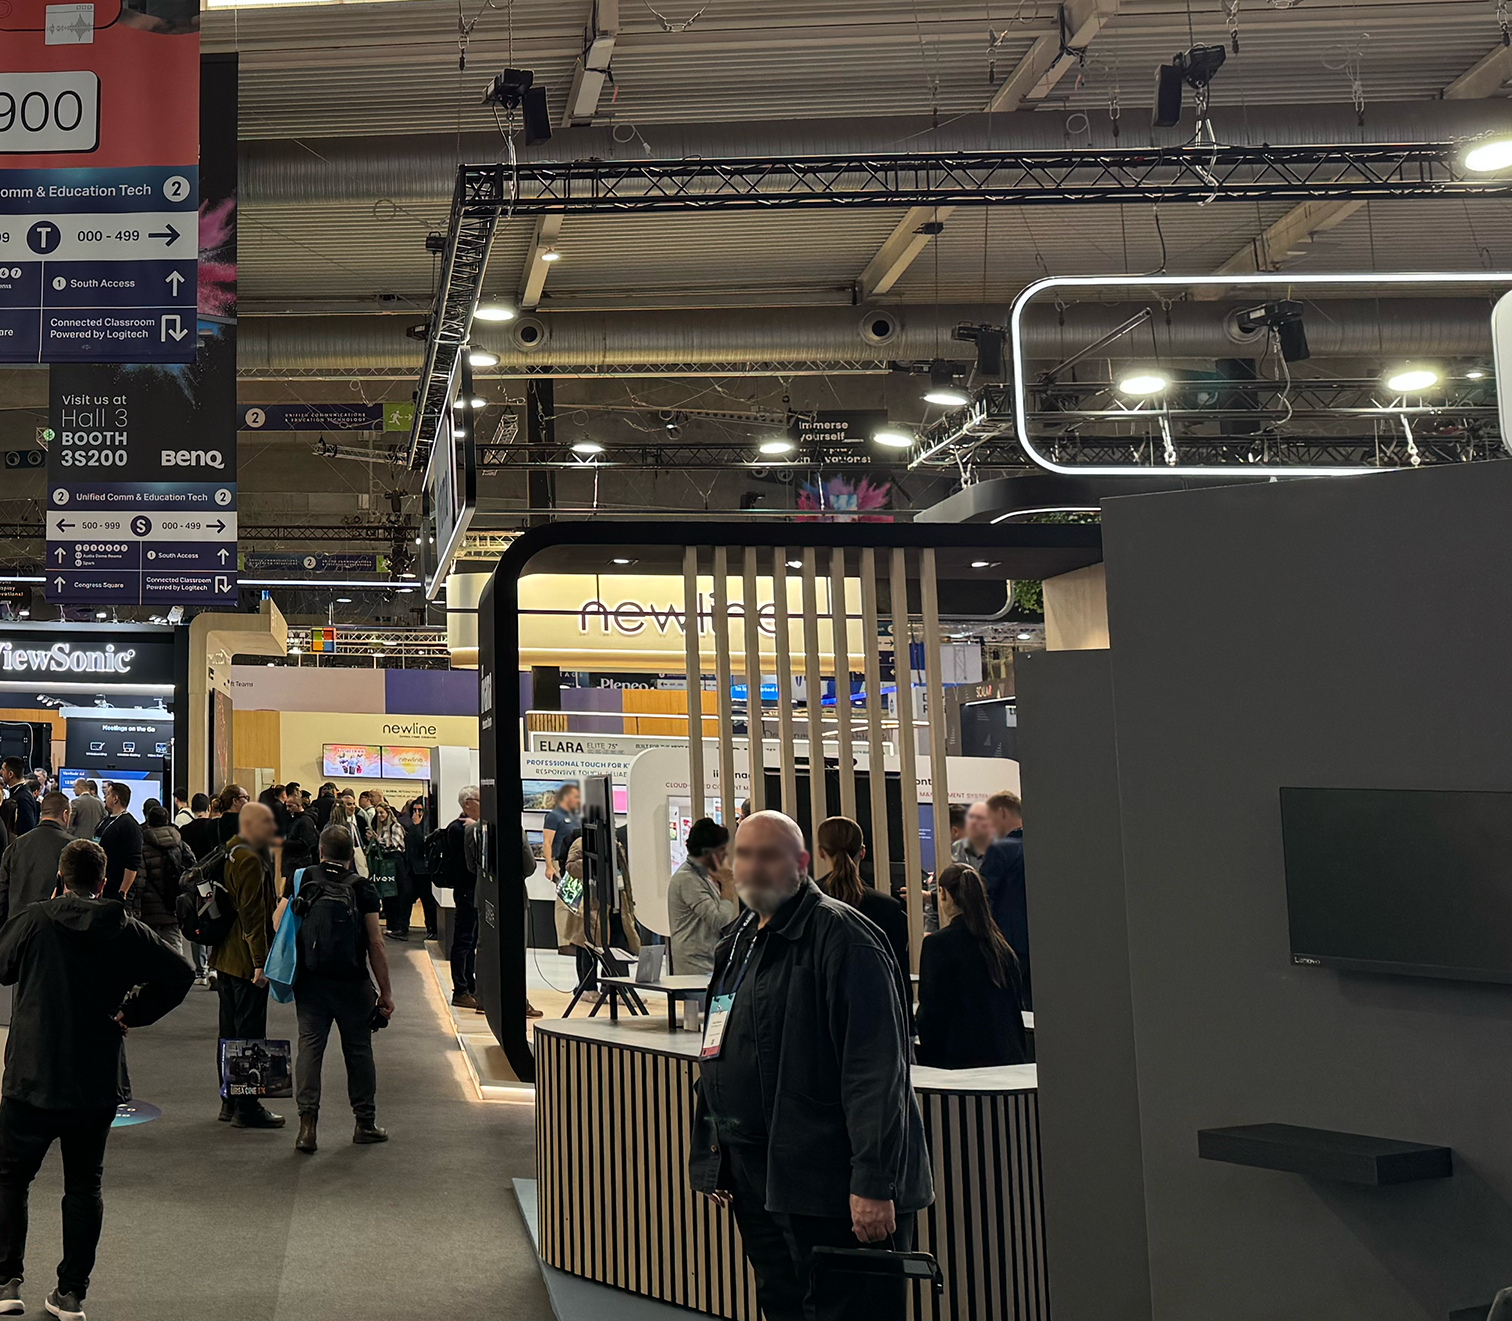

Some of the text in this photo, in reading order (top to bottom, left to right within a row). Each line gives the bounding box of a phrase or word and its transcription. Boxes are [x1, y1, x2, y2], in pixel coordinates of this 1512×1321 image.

[36, 185, 46, 197] &
[49, 184, 116, 197] Education
[119, 183, 152, 196] Tech
[171, 181, 182, 196] 2
[36, 227, 52, 249] T
[77, 230, 103, 242] 000
[114, 230, 140, 241] 499
[70, 279, 99, 288] South
[100, 279, 135, 288] Access
[50, 317, 155, 327] Connected Classroom
[50, 329, 149, 341] Powered by Logitech
[62, 394, 127, 405] Visit us at
[61, 408, 128, 428] Hall 3
[798, 421, 849, 429] Immerse
[61, 431, 127, 446] BOOTH
[800, 432, 845, 443] yourself
[61, 450, 128, 467] 3S200
[161, 450, 225, 469] BenQ
[76, 493, 105, 501] Unified
[107, 493, 134, 501] Comm
[135, 493, 142, 501] &
[143, 493, 186, 501] Education
[187, 493, 208, 501] Tech
[136, 519, 146, 533] S
[162, 522, 178, 530] 000
[185, 522, 201, 530] 499
[172, 584, 180, 592] by
[181, 584, 208, 592] Logitech
[101, 724, 127, 733] Meetings
[382, 722, 437, 735] newline
[539, 740, 584, 753] ELARA
[586, 742, 605, 750] ELITE
[526, 759, 579, 768] PROFESSIONAL
[535, 768, 577, 776] RESPONSIVE
[1293, 956, 1321, 965] Lenovo
